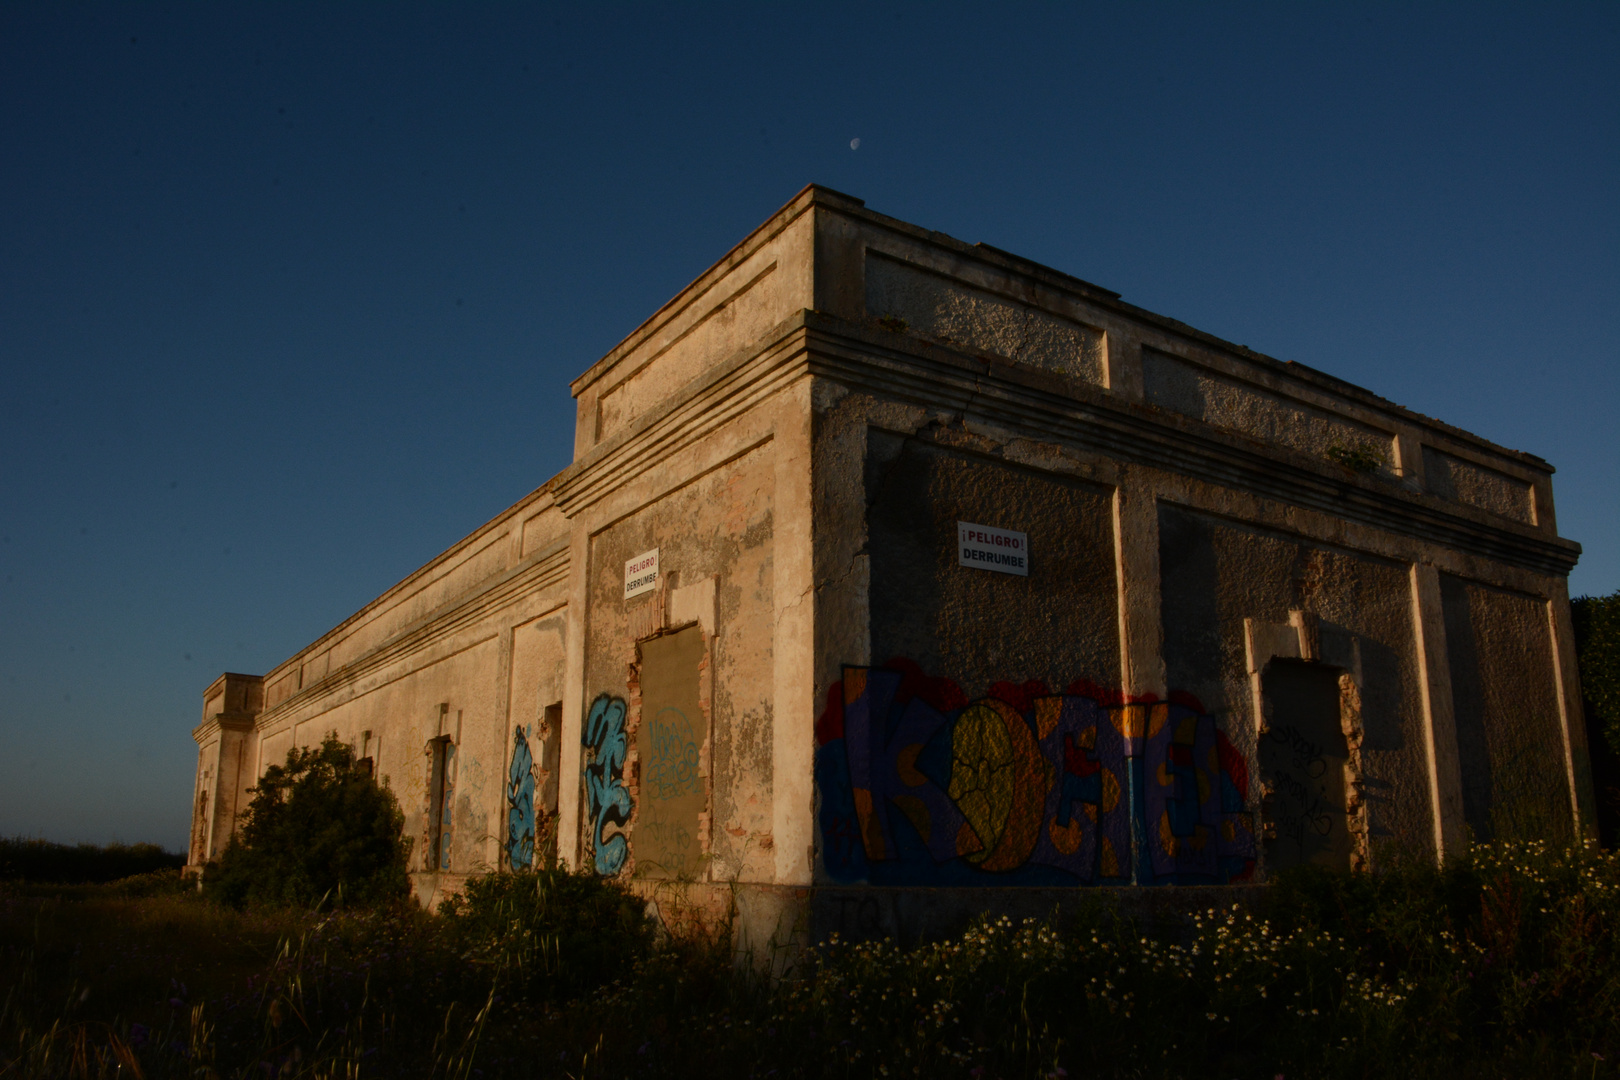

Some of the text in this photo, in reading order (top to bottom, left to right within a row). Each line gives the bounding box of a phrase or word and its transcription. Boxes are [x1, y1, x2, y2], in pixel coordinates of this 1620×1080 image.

[962, 530, 1024, 551] ¡PELIGRO!
[626, 554, 657, 578] ¡PELIGRO!
[963, 548, 1024, 568] DERRUMBE
[626, 572, 657, 592] DERRUMBE
